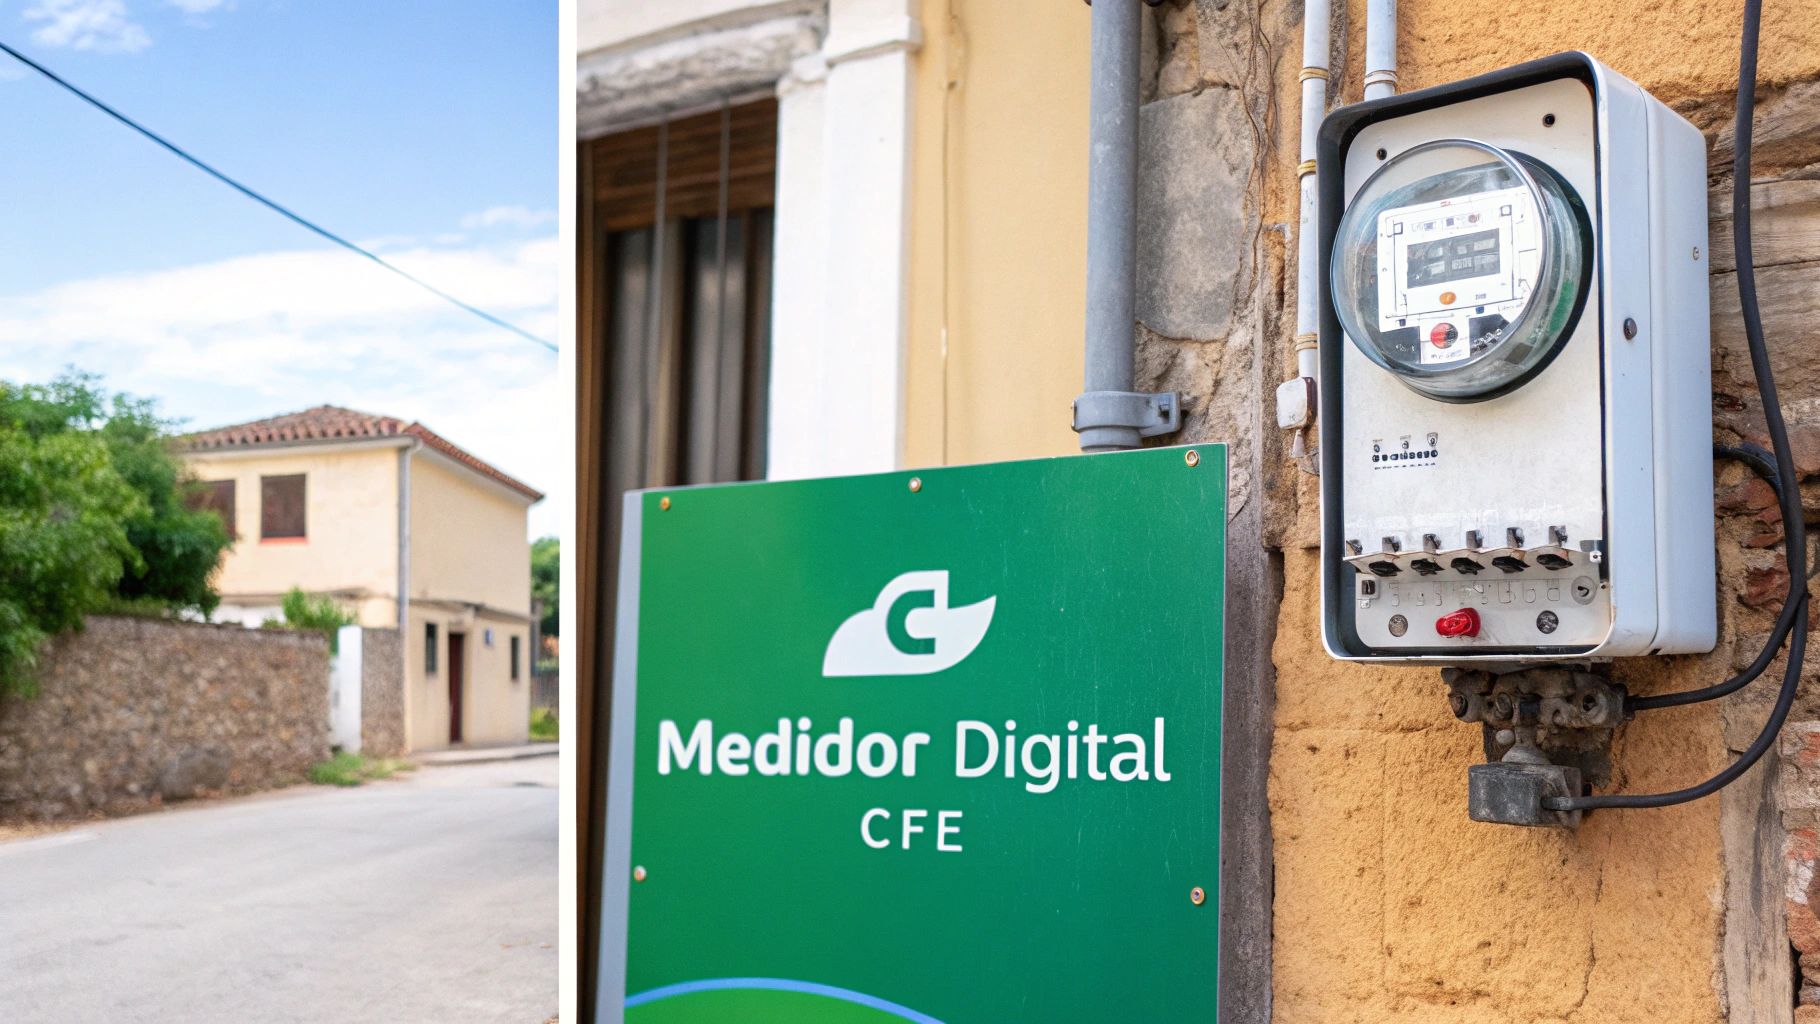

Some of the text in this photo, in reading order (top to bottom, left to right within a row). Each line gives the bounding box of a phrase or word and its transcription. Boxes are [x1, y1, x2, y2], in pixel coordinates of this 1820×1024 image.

[657, 716, 1172, 794] Medidor Digital
[860, 807, 963, 852] CFE
